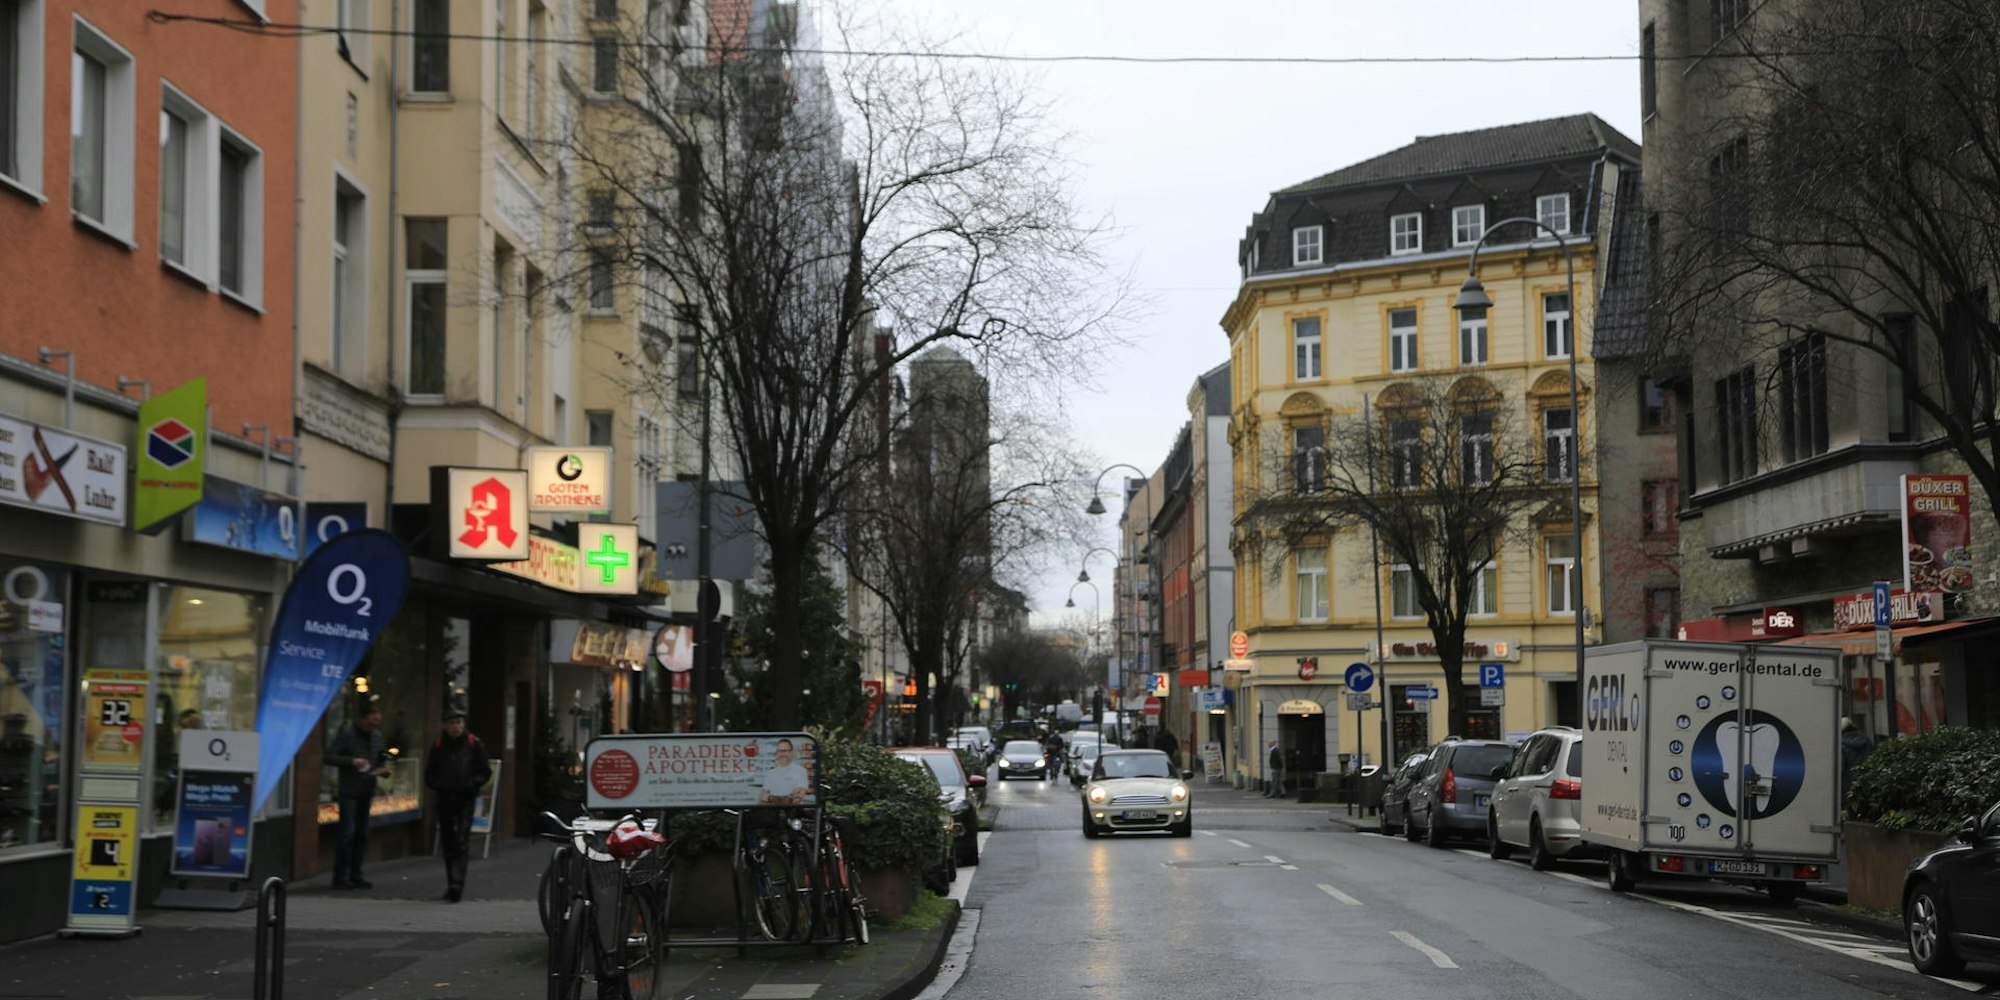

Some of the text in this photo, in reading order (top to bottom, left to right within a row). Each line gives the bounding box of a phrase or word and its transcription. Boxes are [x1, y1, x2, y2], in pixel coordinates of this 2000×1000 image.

[548, 483, 590, 494] GOTEN
[1909, 478, 1963, 495] DÜXER
[533, 494, 603, 506] APOTHEKE
[1913, 497, 1957, 512] GRILL
[327, 563, 373, 616] O2
[1847, 594, 1875, 625] DÜXE
[1876, 588, 1886, 622] P
[304, 619, 370, 641] Mobilfunk
[1768, 613, 1795, 628] DER
[278, 640, 326, 660] Service
[321, 664, 345, 679] LTE
[1485, 667, 1498, 686] P
[1664, 658, 1823, 678] www.gerl-dental.de
[1586, 673, 1628, 732] GERL
[103, 700, 130, 725] 32
[648, 744, 742, 759] PARADIES
[645, 759, 757, 774] APOTHEKE
[1669, 824, 1685, 841] 100
[104, 842, 119, 864] 4
